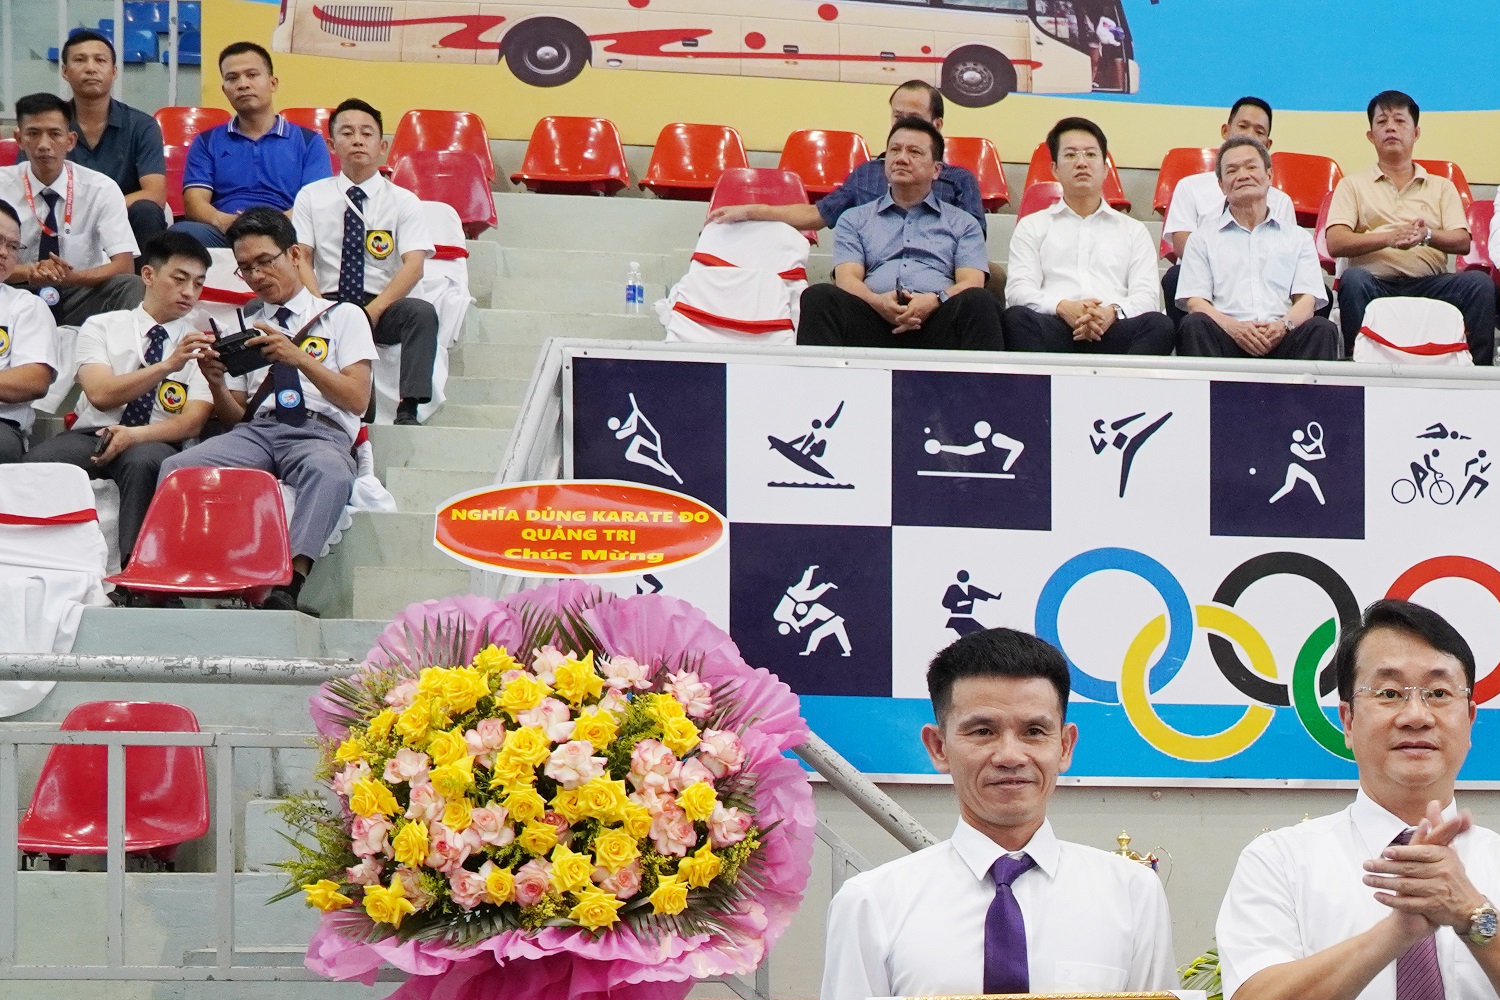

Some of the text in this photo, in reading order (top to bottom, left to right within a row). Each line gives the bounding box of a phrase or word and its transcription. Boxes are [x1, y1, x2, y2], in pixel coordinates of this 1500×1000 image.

[451, 506, 520, 522] NGHĨA
[592, 510, 673, 522] KARATE
[678, 511, 709, 523] ĐO
[521, 525, 636, 543] QUẢNG TRỊ
[504, 547, 664, 563] Chúc Mừng
